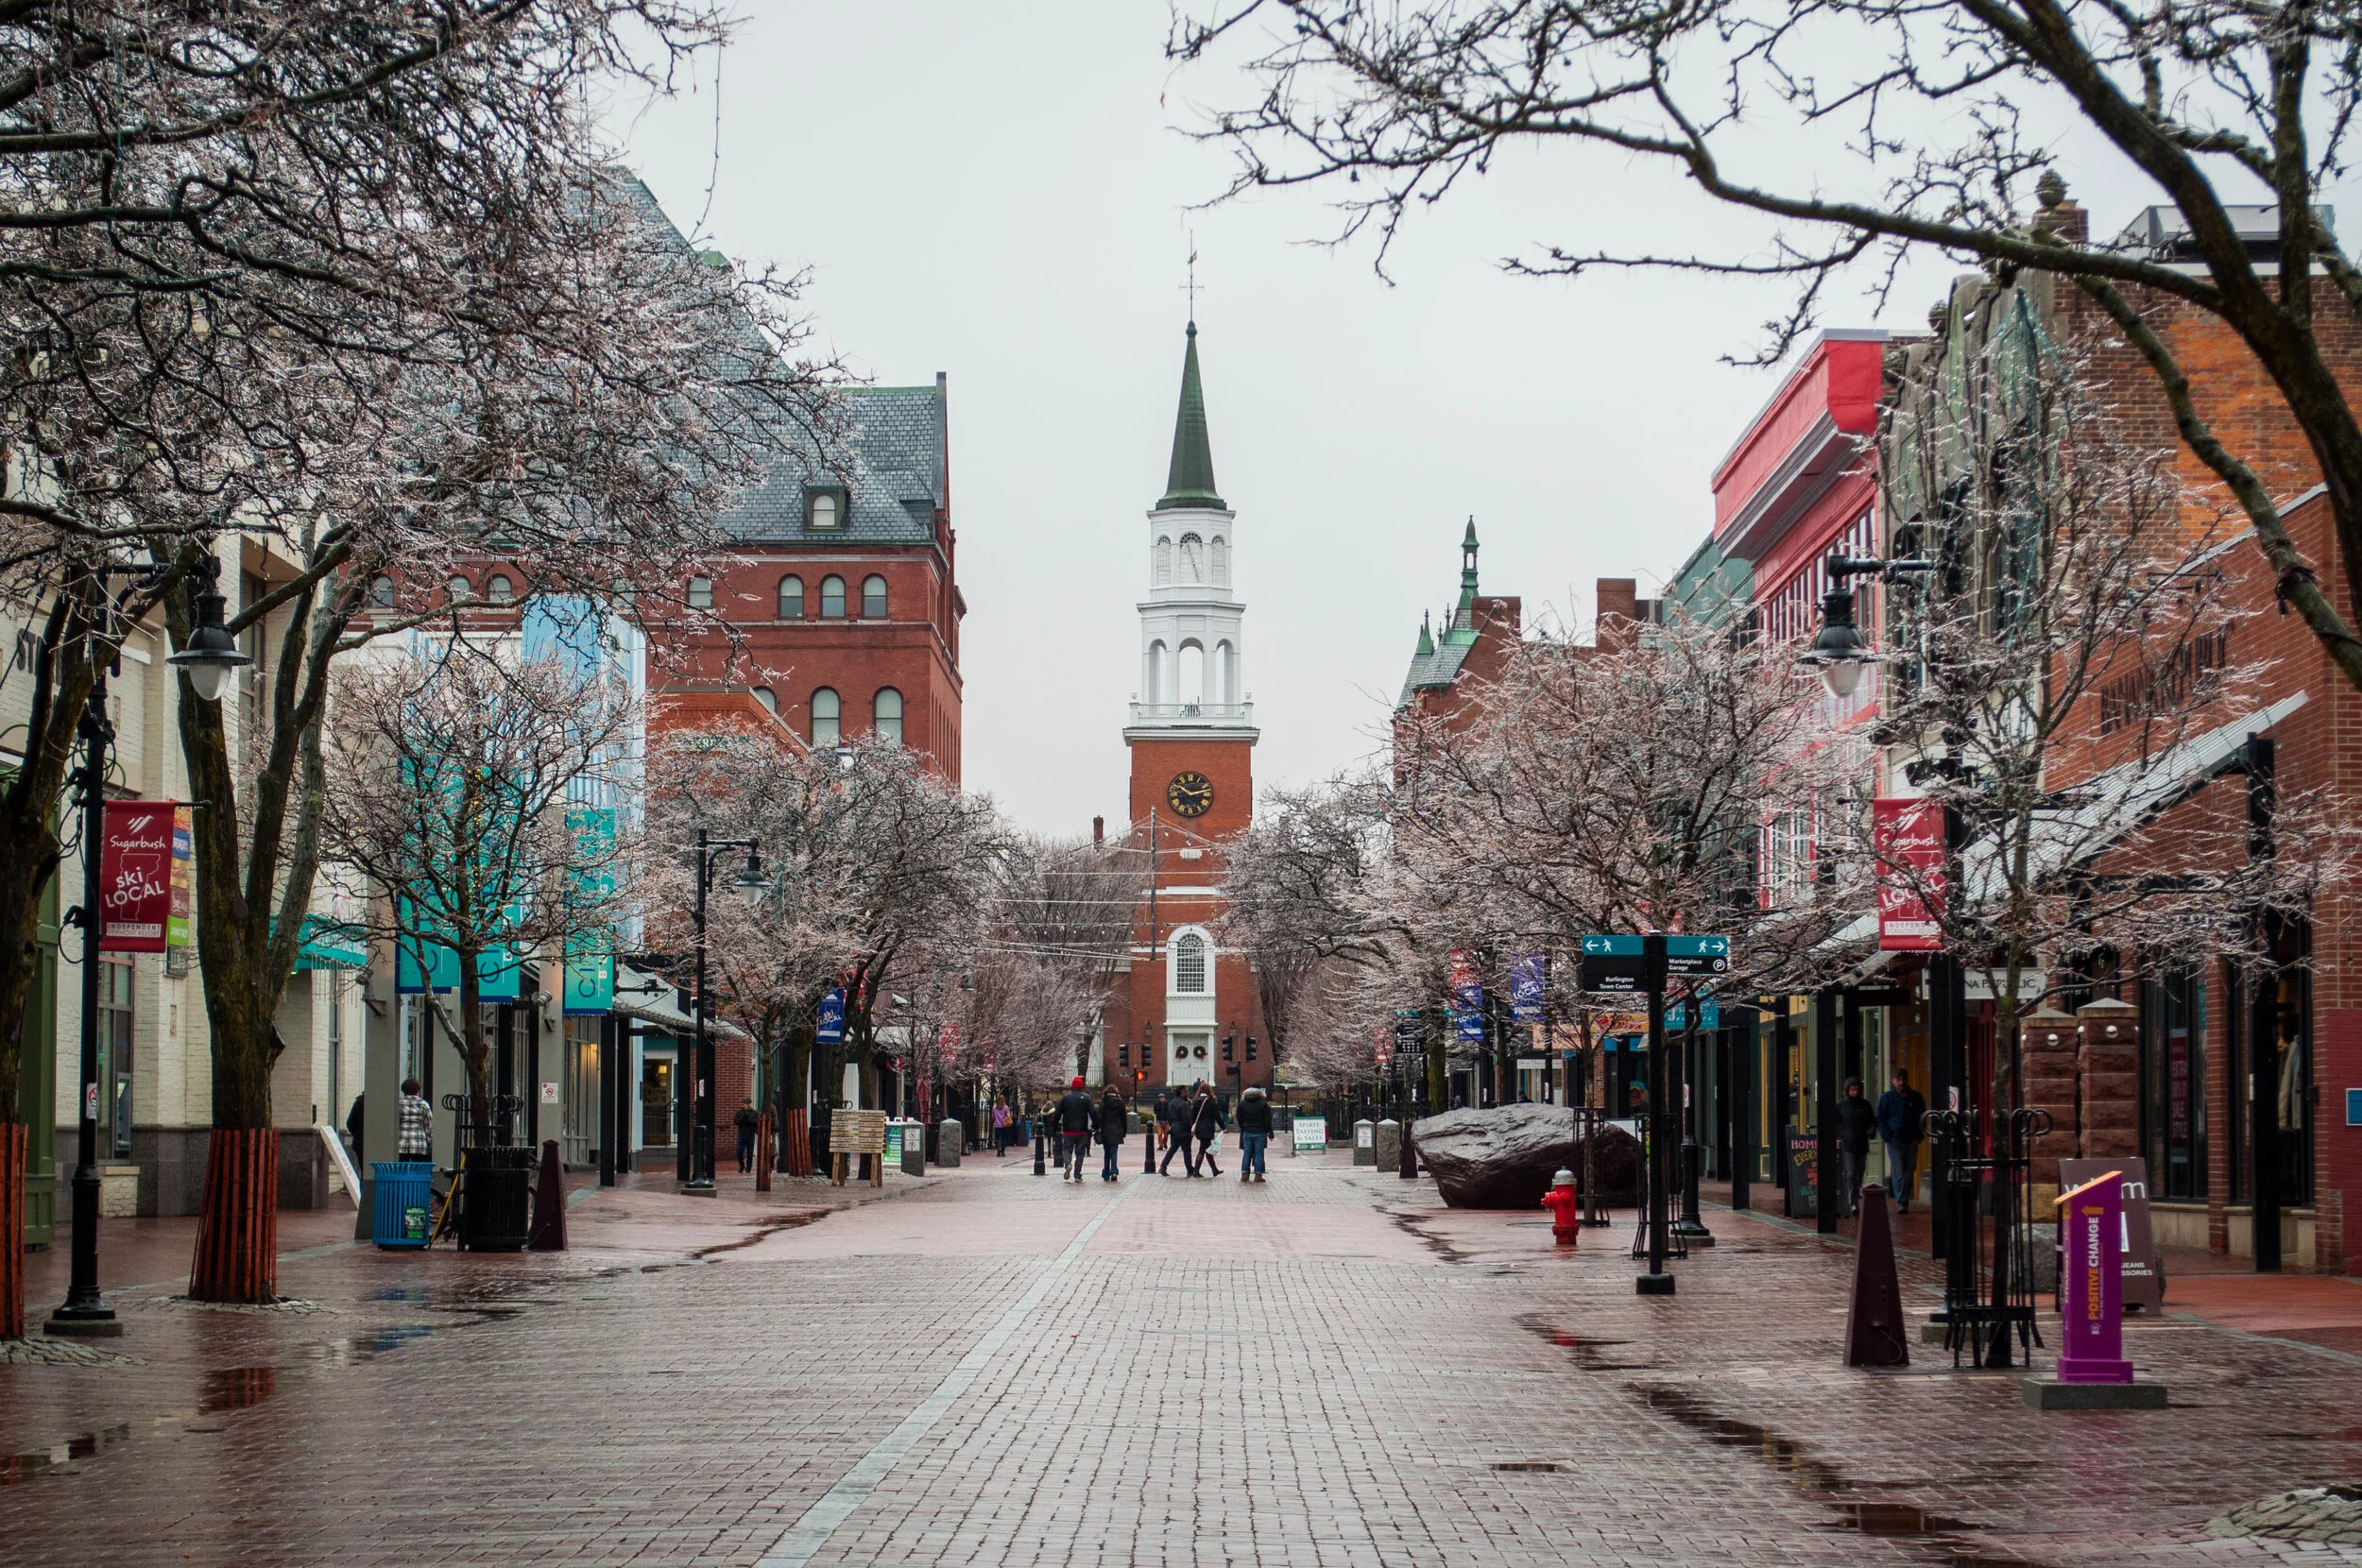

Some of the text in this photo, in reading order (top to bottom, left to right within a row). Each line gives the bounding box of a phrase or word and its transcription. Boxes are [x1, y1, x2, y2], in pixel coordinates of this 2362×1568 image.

[110, 835, 165, 852] Sugarbush
[1880, 833, 1939, 850] Sgarbush
[115, 866, 144, 888] ski
[105, 881, 165, 908] LOCAL
[1514, 986, 1540, 999] LOCAL
[819, 1015, 842, 1025] LOCAL
